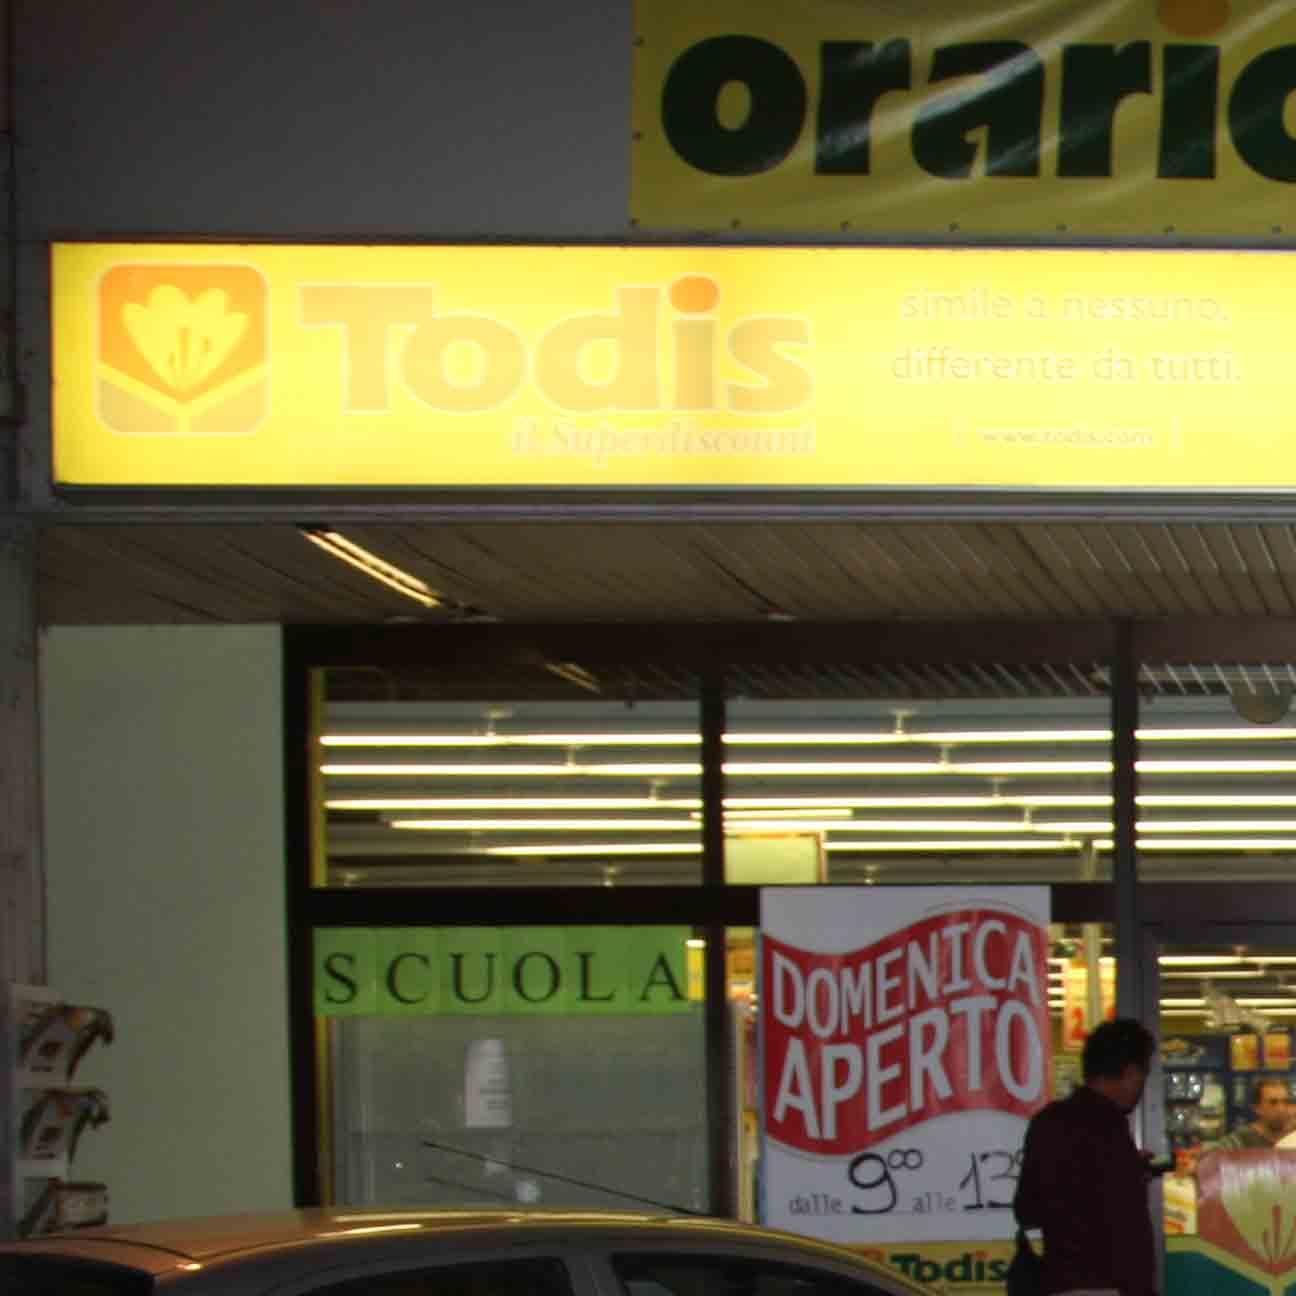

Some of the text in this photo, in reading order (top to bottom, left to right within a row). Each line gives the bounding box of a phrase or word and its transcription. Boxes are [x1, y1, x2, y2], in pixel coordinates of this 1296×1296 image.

[902, 287, 1014, 320] simile
[1024, 294, 1049, 320] a
[298, 272, 816, 415] Todis
[891, 345, 1076, 381] differente
[1093, 347, 1137, 381] da
[323, 950, 686, 1004] SCUOLA
[771, 914, 1038, 1029] DOMENICA
[773, 993, 1045, 1141] APERTO
[788, 1192, 843, 1215] dalle
[912, 1191, 957, 1214] alle
[890, 1249, 1008, 1283] Todis
